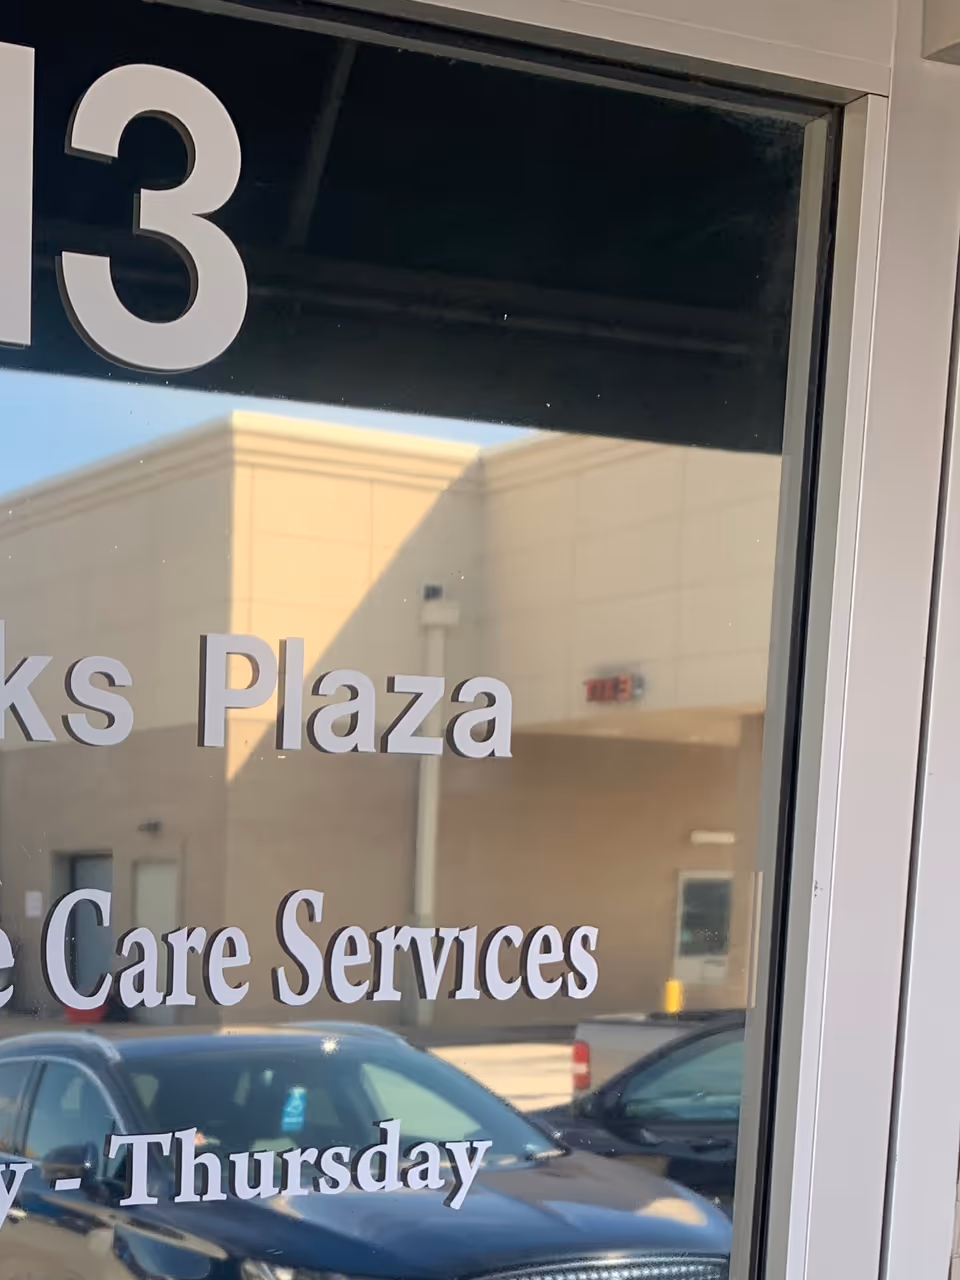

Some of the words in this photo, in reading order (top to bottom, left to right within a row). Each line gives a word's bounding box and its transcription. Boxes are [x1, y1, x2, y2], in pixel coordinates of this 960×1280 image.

[197, 633, 513, 759] Plaza
[42, 887, 251, 1009] Care
[273, 888, 599, 1006] Services
[106, 1118, 493, 1210] Thursday
